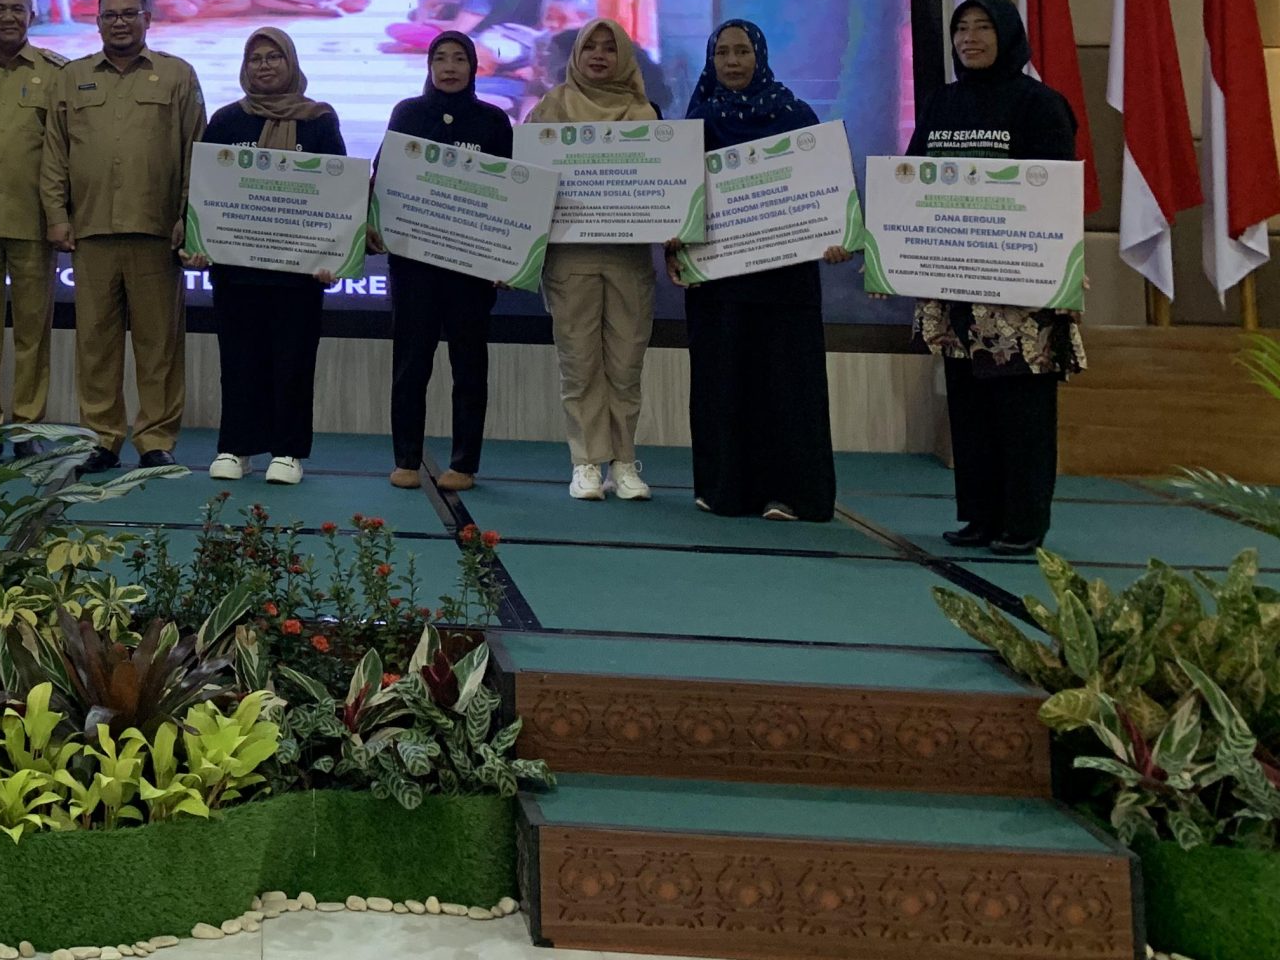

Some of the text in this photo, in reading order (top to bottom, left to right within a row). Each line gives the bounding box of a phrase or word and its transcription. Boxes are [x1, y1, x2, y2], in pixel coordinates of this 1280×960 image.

[928, 129, 1011, 141] AKSI SEKARANG
[810, 186, 839, 198] DALAM
[272, 197, 307, 205] BERGULIR
[204, 200, 352, 220] SIRKULAR EKONOMI PEREMPUAN DALAM
[223, 212, 272, 222] PERHUTANAN
[274, 217, 300, 225] SOSIAL
[963, 216, 1006, 224] BERGULIR
[883, 224, 1063, 240] SIRKULAR EKONOMI PEREMPUAN DALAM
[905, 237, 1038, 252] PERHUTANAN SOSIAL (SEPPS)
